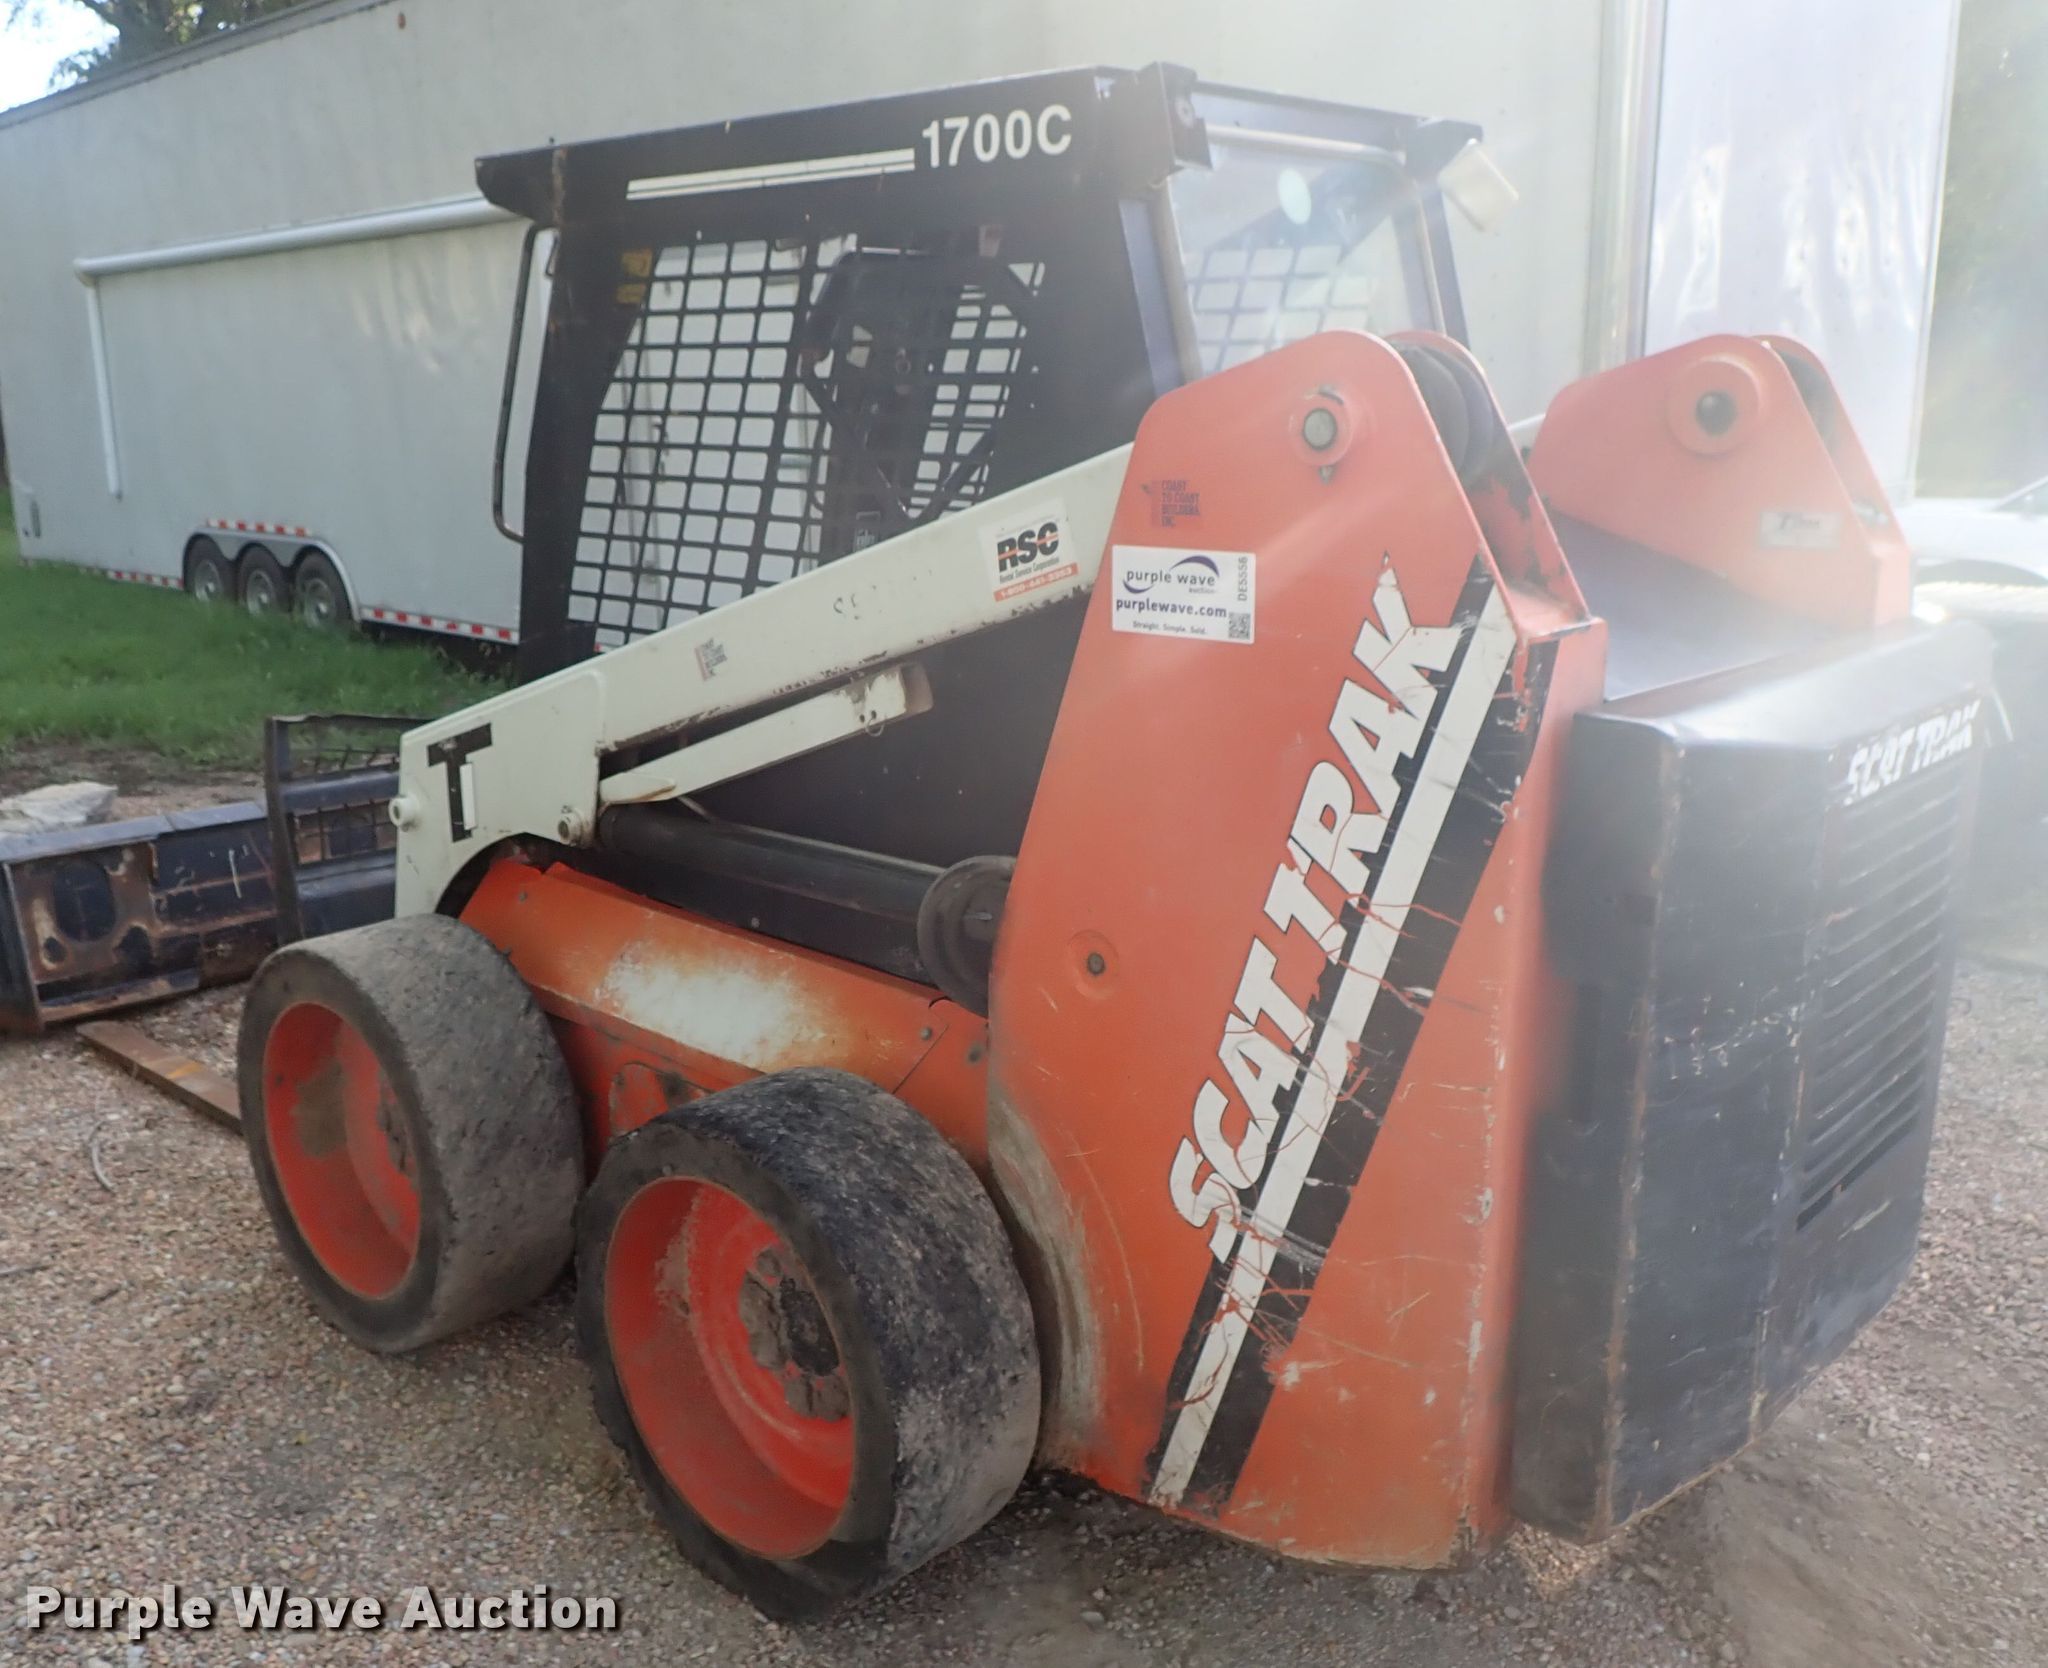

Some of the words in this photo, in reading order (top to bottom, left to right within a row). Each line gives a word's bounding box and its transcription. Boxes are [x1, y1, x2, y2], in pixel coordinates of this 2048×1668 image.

[922, 104, 1072, 168] 1700C
[997, 521, 1060, 573] RSC
[1127, 568, 1172, 584] purple
[1177, 573, 1216, 587] wave
[1116, 598, 1228, 618] purplewave.com
[1169, 934, 1315, 1264] SCAT
[1263, 552, 1468, 966] TRAK
